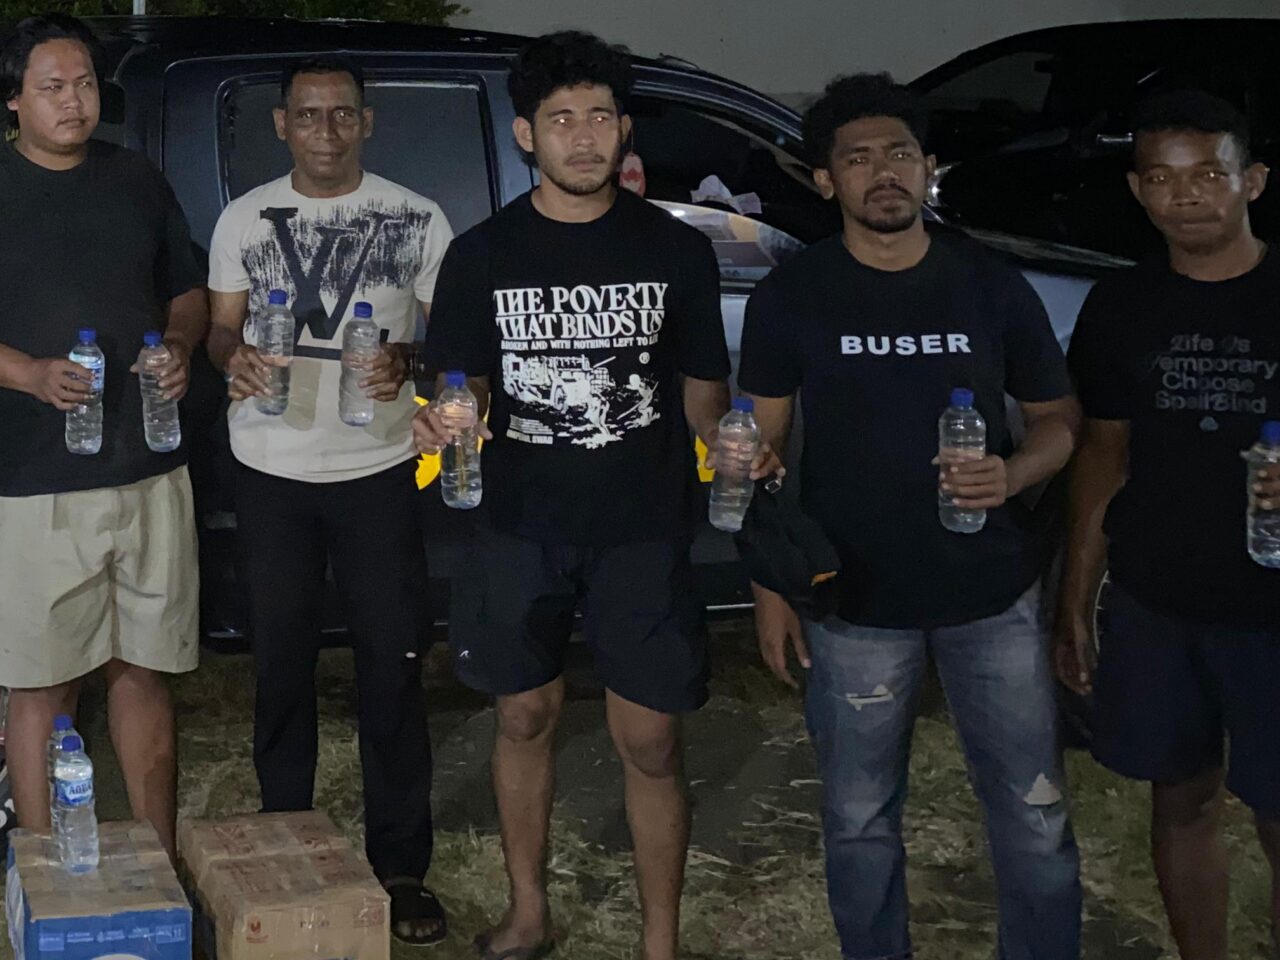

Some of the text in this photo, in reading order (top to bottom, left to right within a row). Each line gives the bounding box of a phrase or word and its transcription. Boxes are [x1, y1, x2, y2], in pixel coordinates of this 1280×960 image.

[493, 283, 668, 316] THE POVERTY
[495, 310, 665, 340] THAT BINDS US
[501, 340, 528, 350] BROKEN
[531, 340, 548, 350] AND
[551, 339, 571, 350] WITH
[573, 339, 610, 349] NOTHING
[613, 337, 633, 348] LEFT
[636, 337, 648, 346] TO
[841, 334, 971, 355] BUSER
[1162, 371, 1255, 392] Choose
